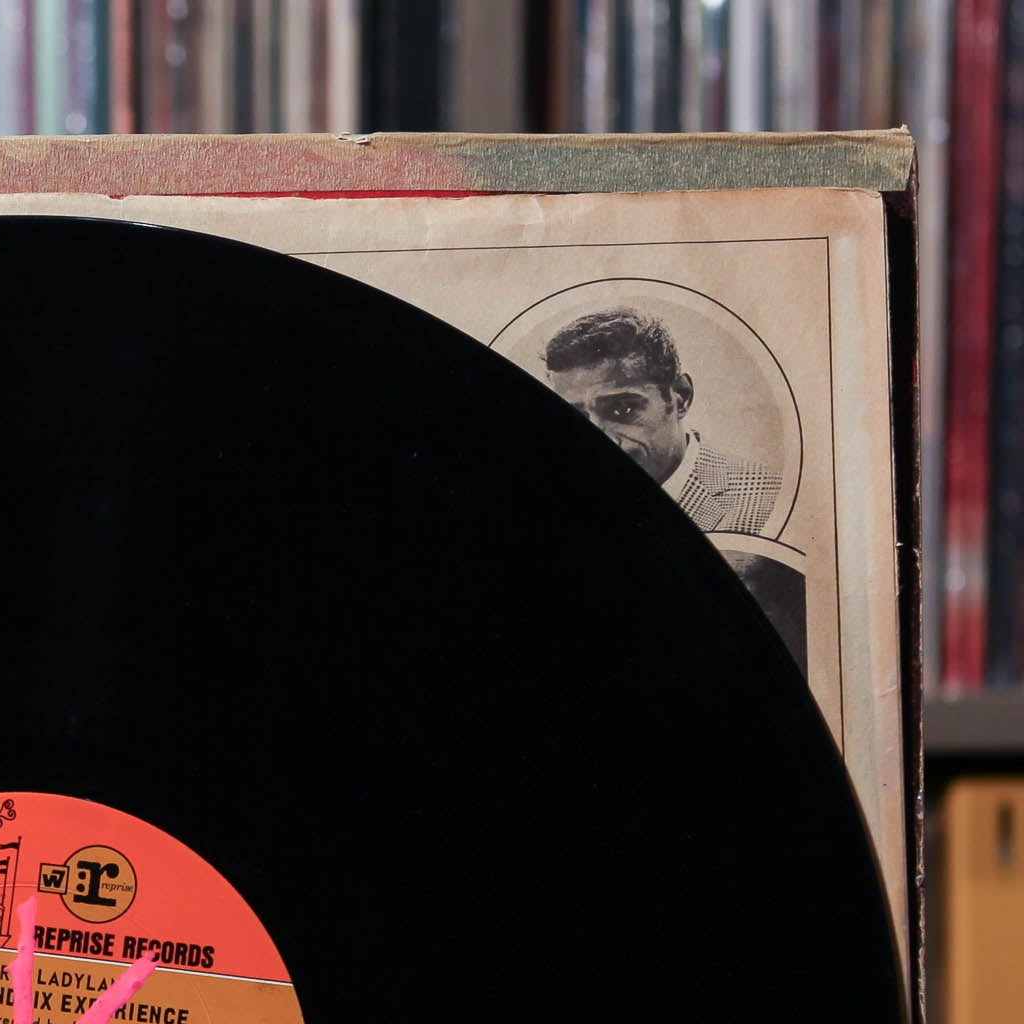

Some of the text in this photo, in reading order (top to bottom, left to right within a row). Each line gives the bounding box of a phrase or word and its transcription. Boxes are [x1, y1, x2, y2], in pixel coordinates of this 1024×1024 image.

[101, 881, 134, 893] reprise
[34, 925, 215, 969] REPRISE RECORDS
[37, 969, 117, 992] LADYLA
